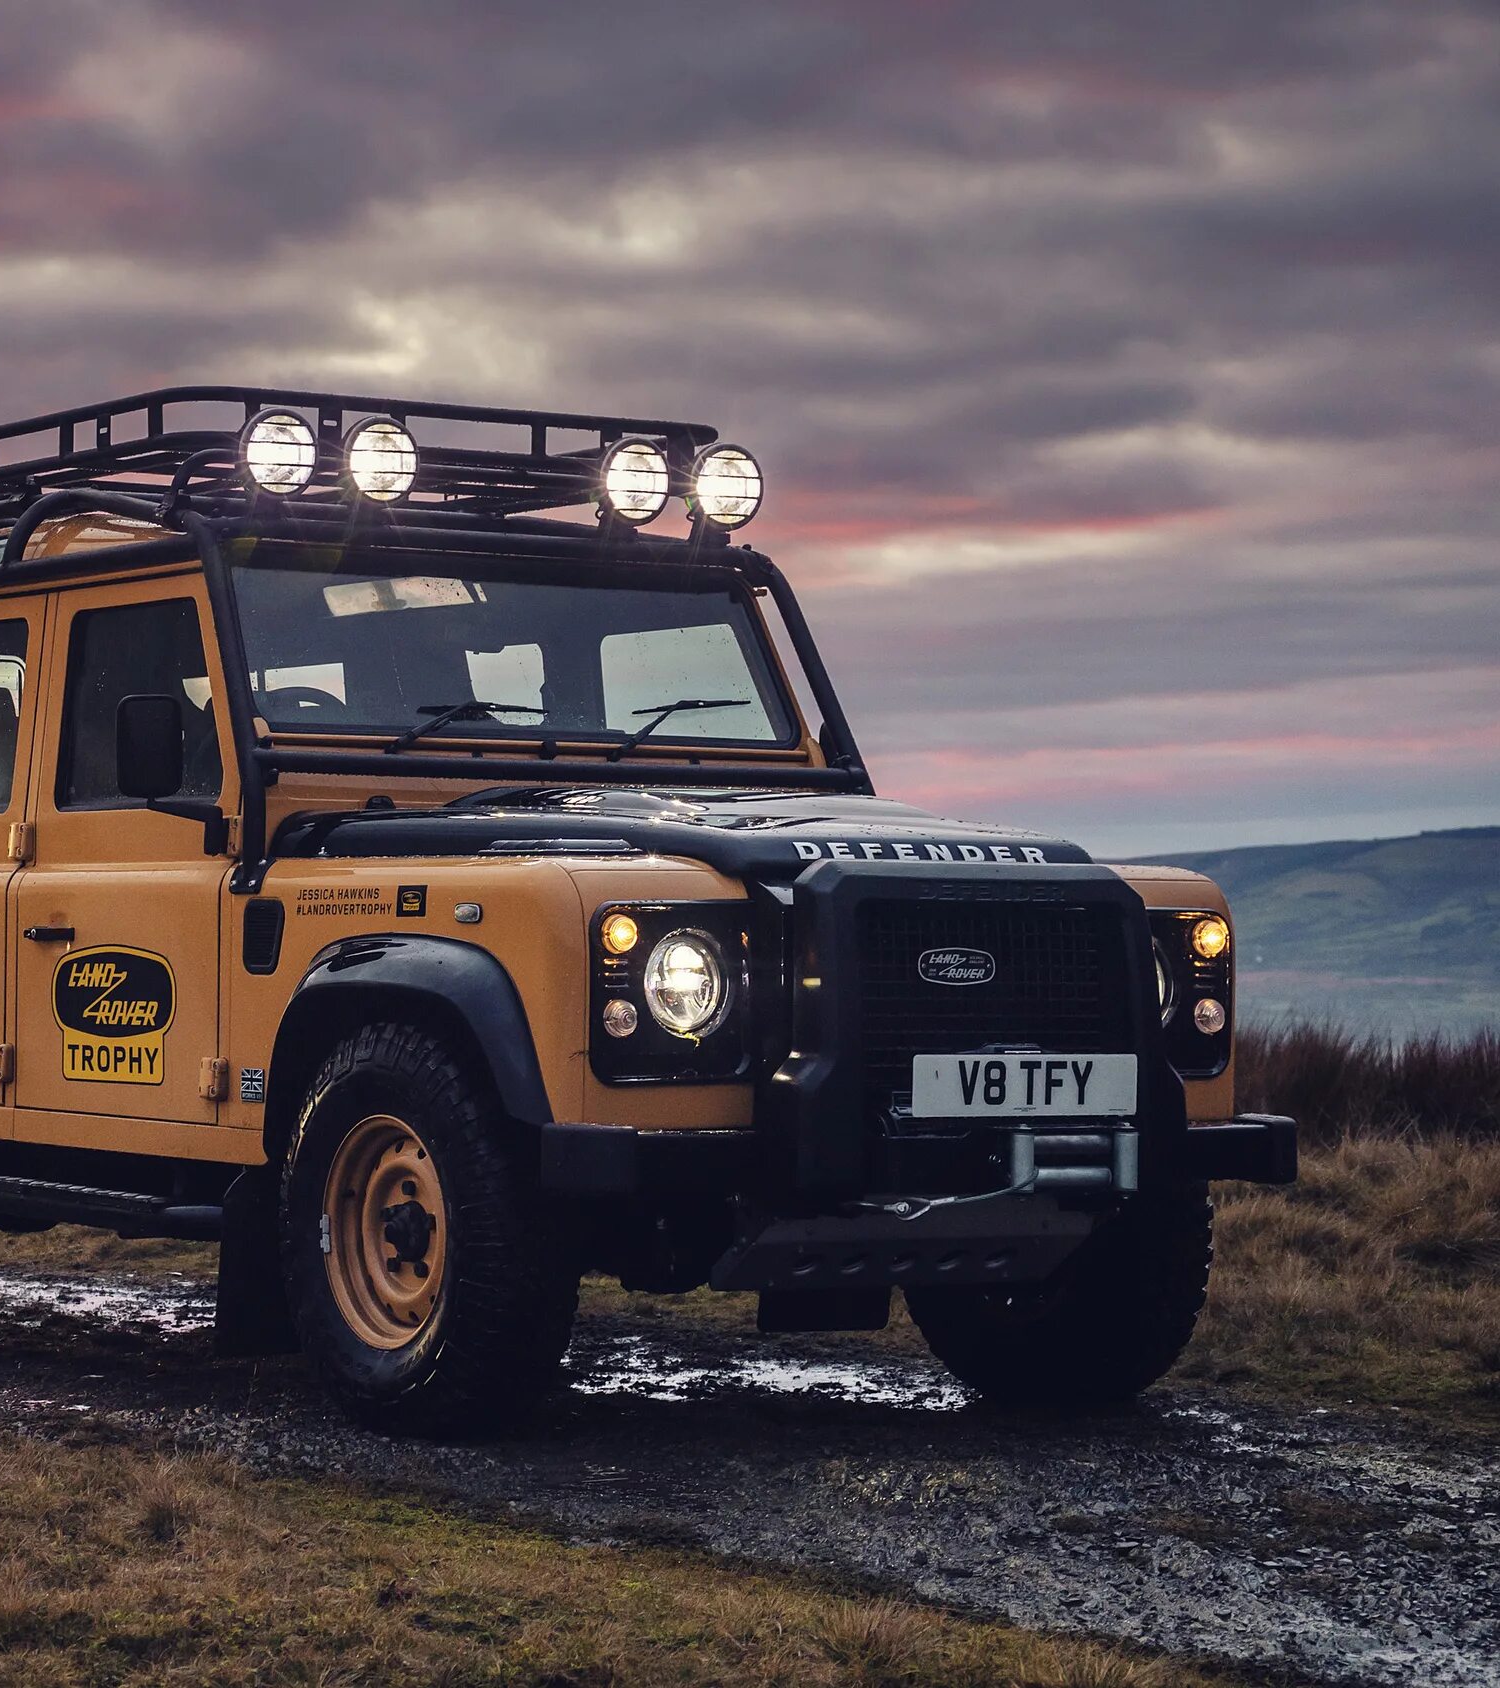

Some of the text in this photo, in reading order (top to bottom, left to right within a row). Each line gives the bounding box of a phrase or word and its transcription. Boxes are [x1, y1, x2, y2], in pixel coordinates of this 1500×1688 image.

[792, 841, 1049, 865] DEFENDER
[297, 887, 380, 901] JESSICA HAWKINS
[296, 903, 392, 916] #LANDROVERTROPHY
[929, 953, 960, 964] LAND
[68, 962, 117, 988] LAND
[947, 968, 986, 979] ROVER
[95, 1000, 159, 1027] ROVER
[67, 1044, 159, 1075] TROPHY
[958, 1060, 1093, 1106] V8 TFY
